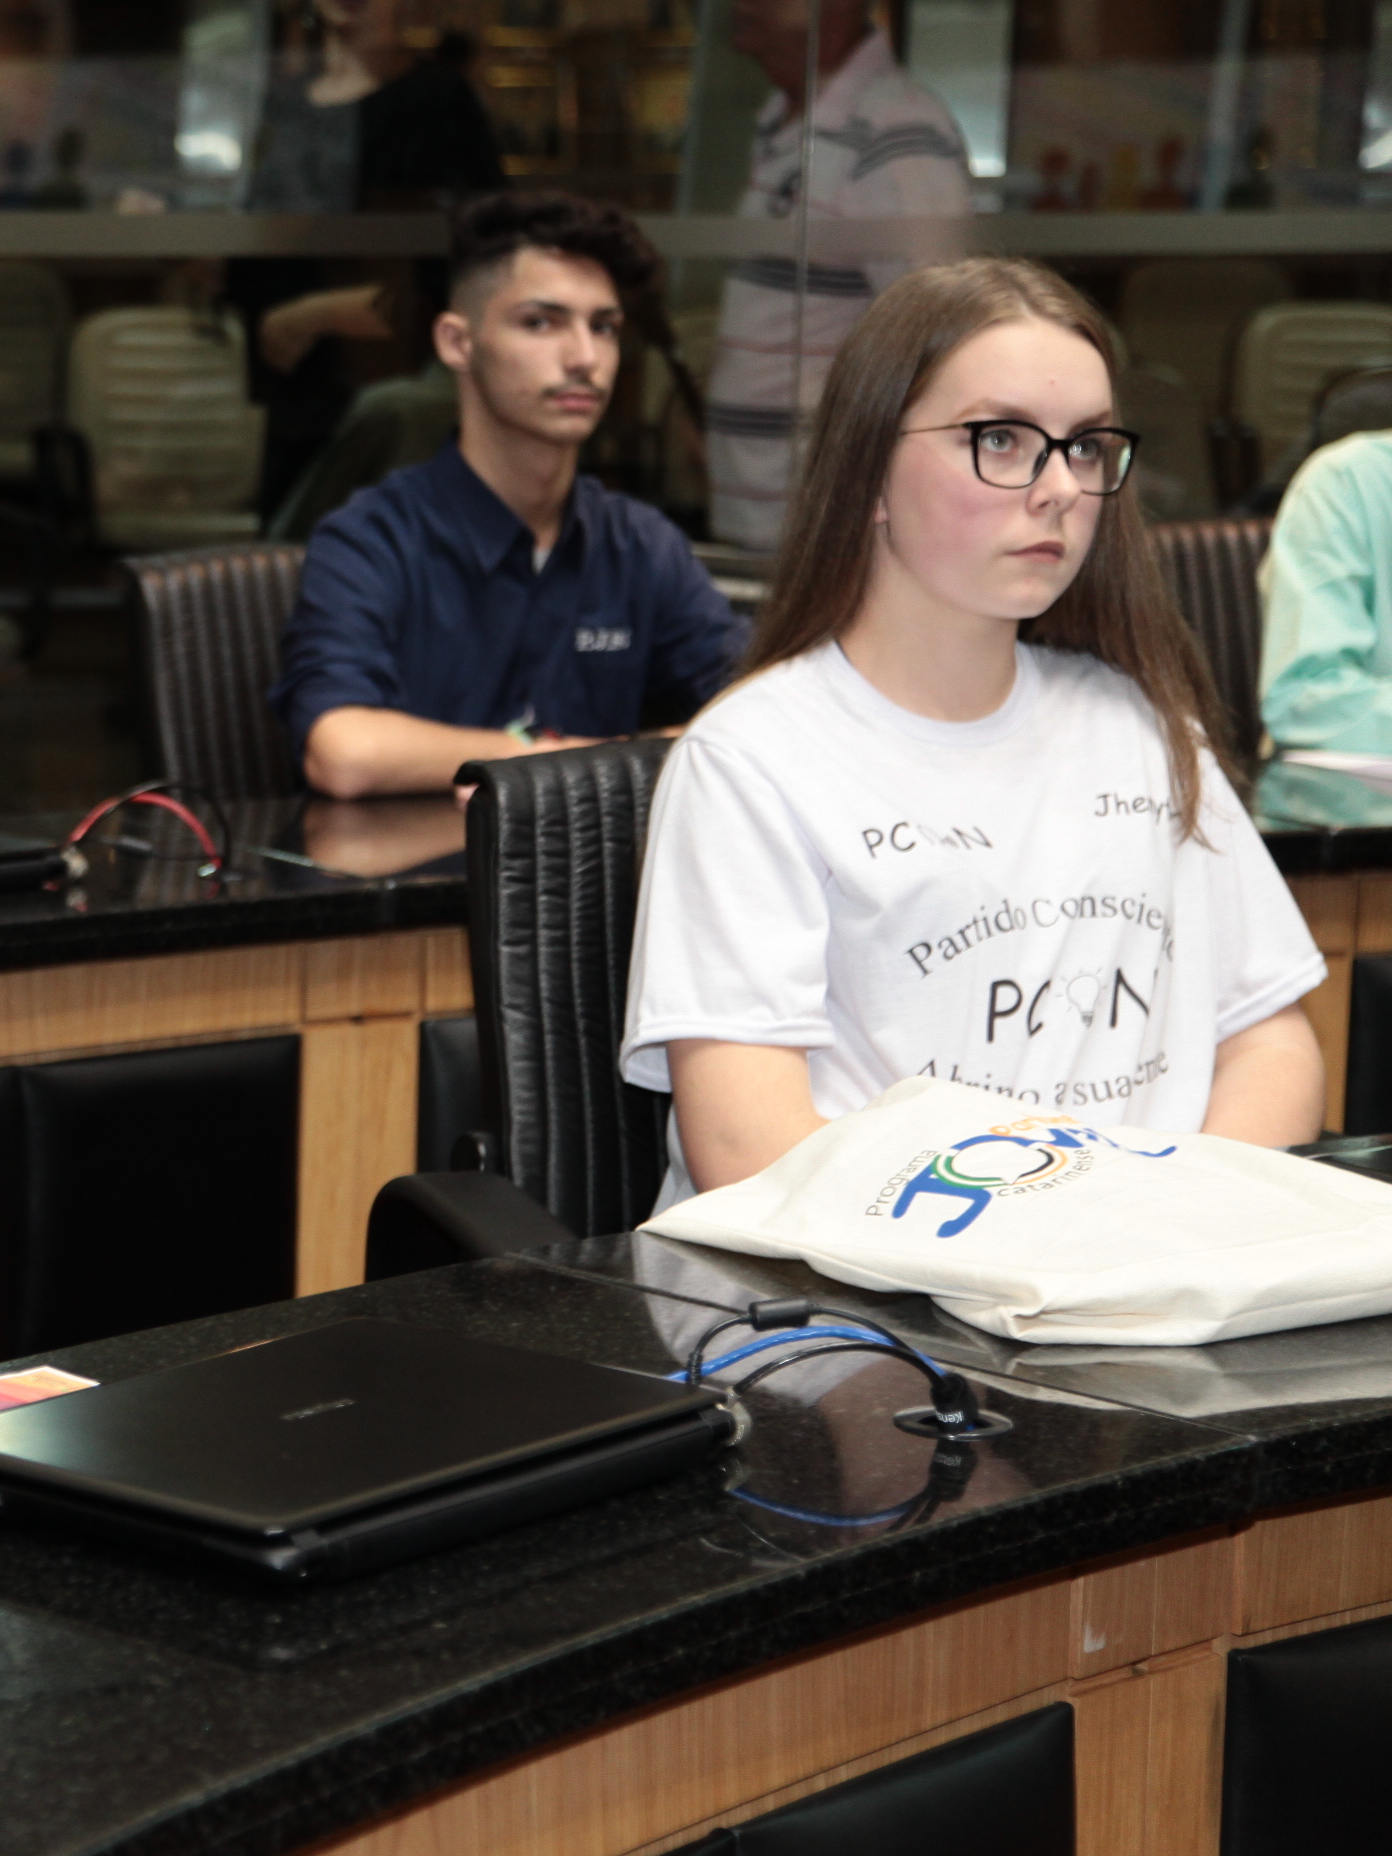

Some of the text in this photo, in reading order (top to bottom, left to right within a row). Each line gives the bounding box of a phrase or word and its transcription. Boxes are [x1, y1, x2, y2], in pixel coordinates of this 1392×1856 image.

[906, 898, 1027, 978] Partido
[1072, 1075, 1132, 1106] sua
[865, 1150, 938, 1216] Programa
